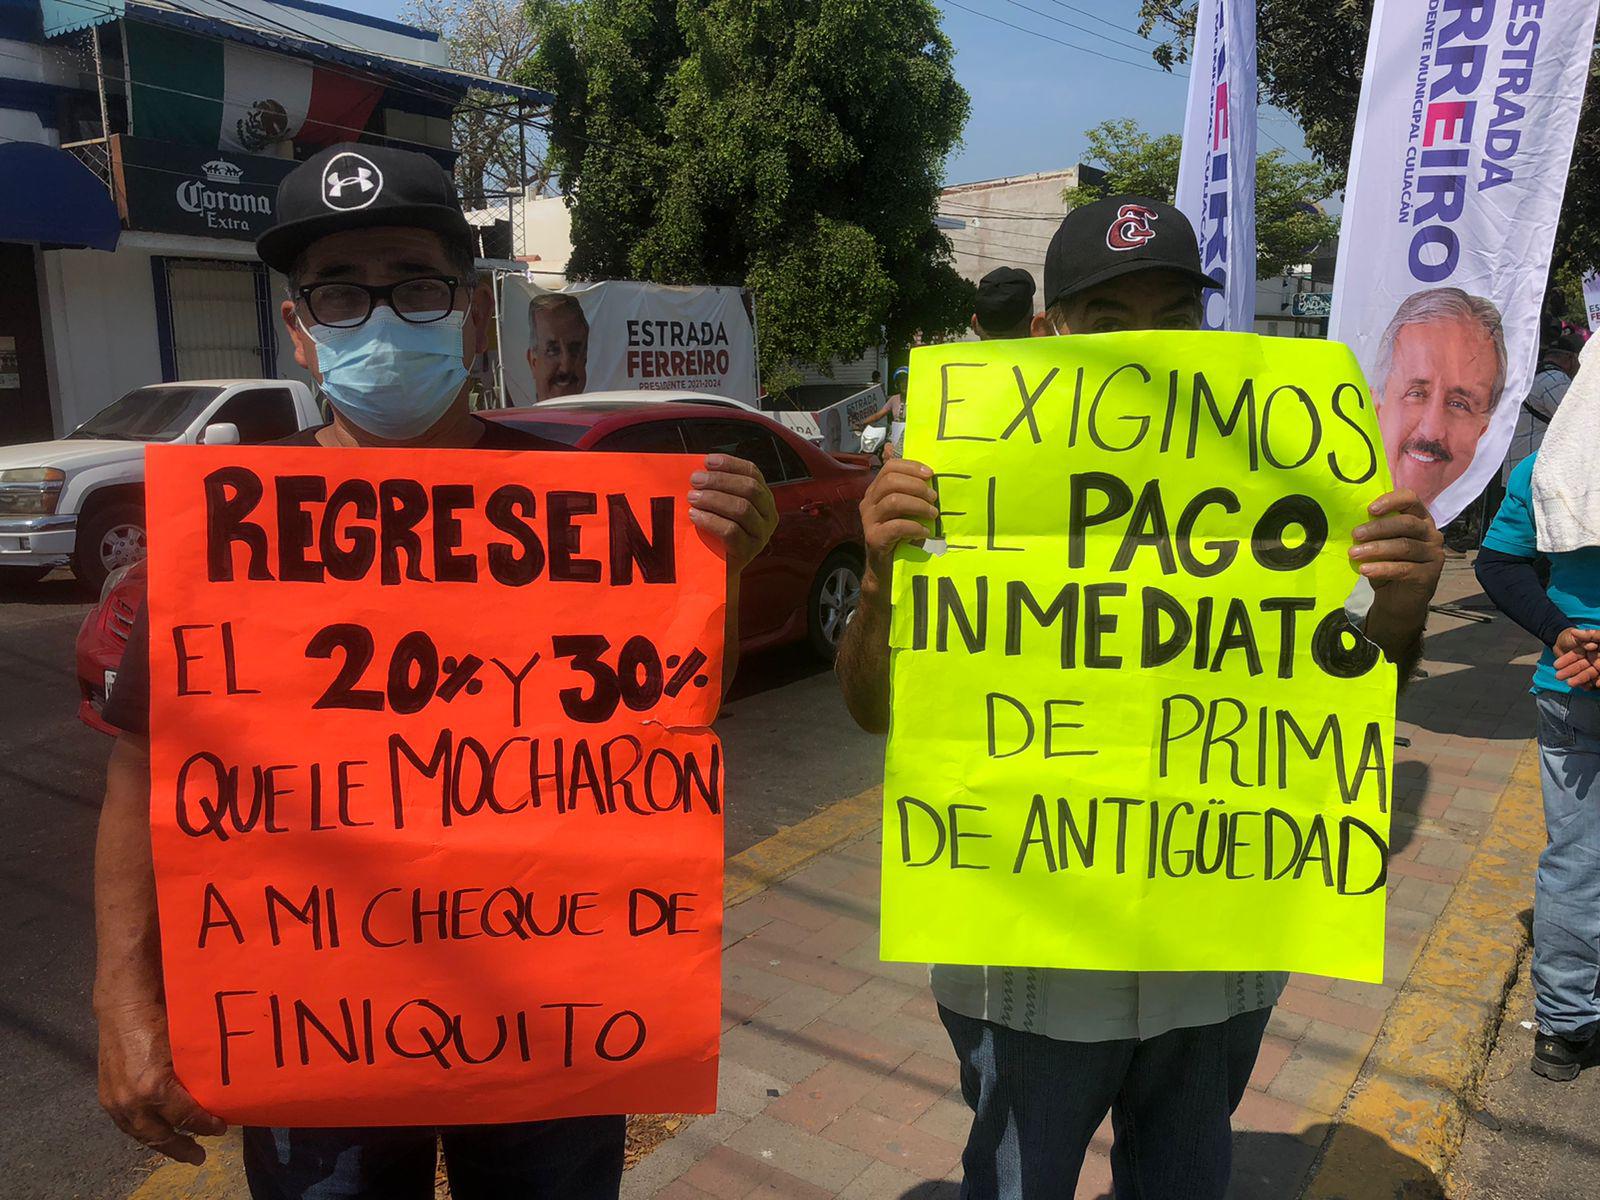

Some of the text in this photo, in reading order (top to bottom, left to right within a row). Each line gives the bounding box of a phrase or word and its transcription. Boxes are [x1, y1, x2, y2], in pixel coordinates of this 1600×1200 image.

[1408, 55, 1430, 143] MUNICIPAL
[1477, 0, 1545, 192] ESTRADA
[176, 180, 272, 217] Corona
[207, 211, 250, 231] Extra
[1398, 146, 1417, 223] CULIACÁN
[626, 319, 729, 347] ESTRADA
[627, 349, 730, 378] FERREIRO
[639, 380, 686, 391] PRESIDENTE
[936, 362, 1377, 484] EXIGIMOS
[204, 466, 677, 587] REGRESEN
[931, 471, 1329, 578] EL PAGO
[172, 622, 708, 727] EL 20% Y 30%
[912, 575, 1380, 679] INMEDIATO
[388, 728, 722, 830] MOCHARON
[985, 692, 1388, 814] DE PRIMA
[897, 794, 1389, 896] DE ANTIGÜEDAD
[198, 882, 700, 950] A MI CHEQUE DE
[214, 990, 648, 1086] FINIQUITO
